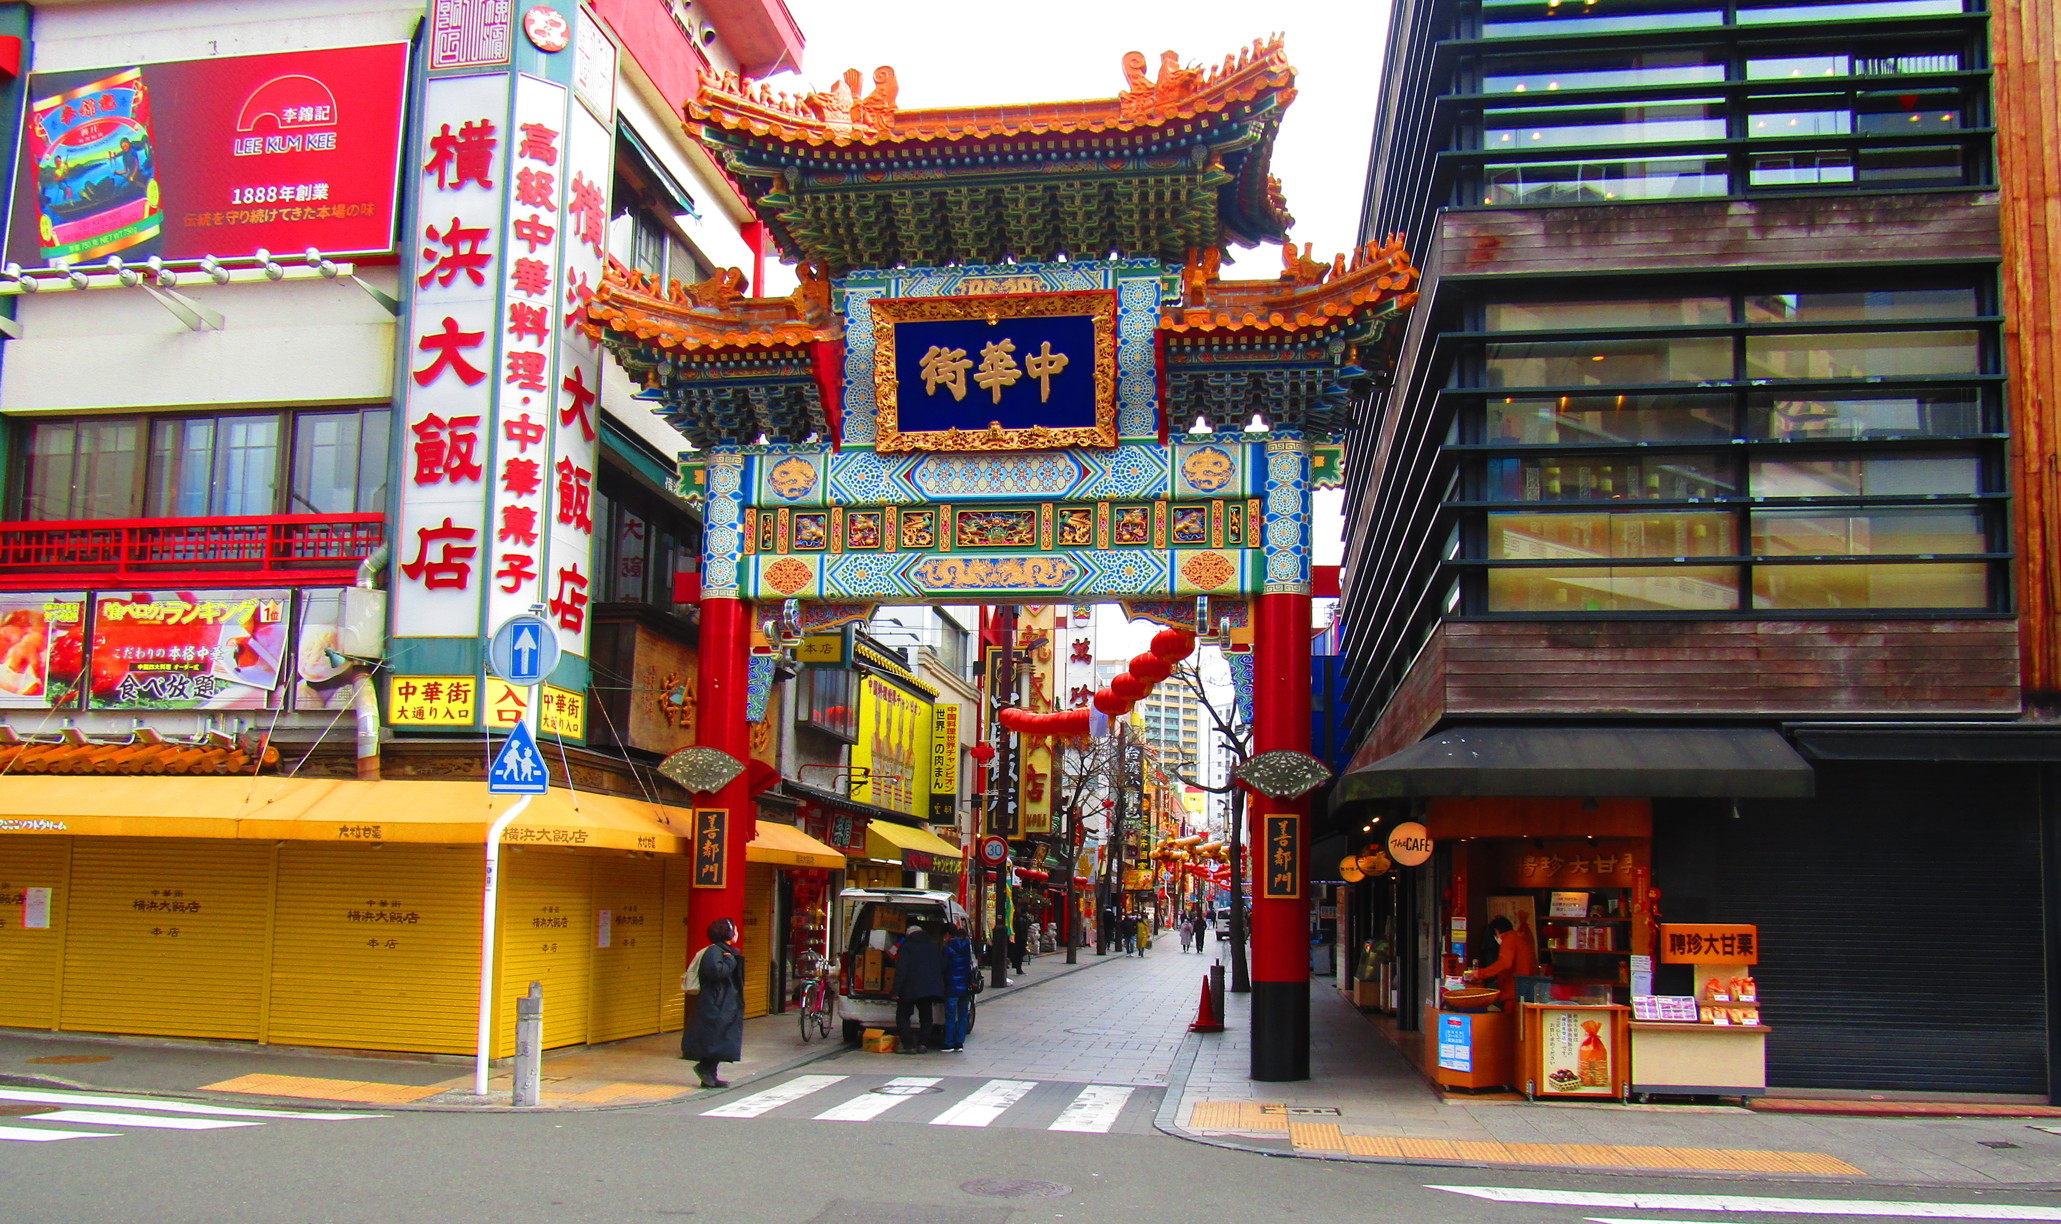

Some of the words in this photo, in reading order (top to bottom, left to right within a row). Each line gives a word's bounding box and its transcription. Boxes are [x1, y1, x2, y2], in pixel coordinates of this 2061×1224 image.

[282, 105, 331, 123] 李錦記
[234, 138, 262, 156] LEE
[266, 135, 303, 153] KUM
[306, 133, 337, 151] KEE
[232, 183, 329, 204] 1888年創業
[183, 202, 375, 227] 伝統を守り続けてきた本場の味
[402, 118, 498, 591] 横浜大飯店
[497, 122, 559, 593] 高級中華料理・中華菓子
[919, 338, 1069, 404] 中華街
[804, 643, 833, 654] 本店
[118, 673, 216, 700] 食べ放題
[397, 682, 471, 703] 中華街
[397, 706, 469, 721] 大通り入口
[496, 687, 527, 722] 入口
[542, 692, 580, 718] 中華街
[542, 713, 579, 733] 大通り入口
[934, 709, 945, 790] 世界一の肉まん
[945, 706, 957, 793] 中国料理世界チャンピオン
[502, 827, 588, 844] 横浜大飯店
[1390, 839, 1408, 850] The
[1406, 837, 1431, 854] CAFE
[986, 844, 1003, 857] 30
[132, 899, 201, 913] 横浜大飯店
[348, 910, 419, 924] 横浜大飯店
[151, 927, 180, 937] 本店
[366, 939, 398, 950] 本店
[1669, 933, 1753, 956] 聘珍大甘栗
